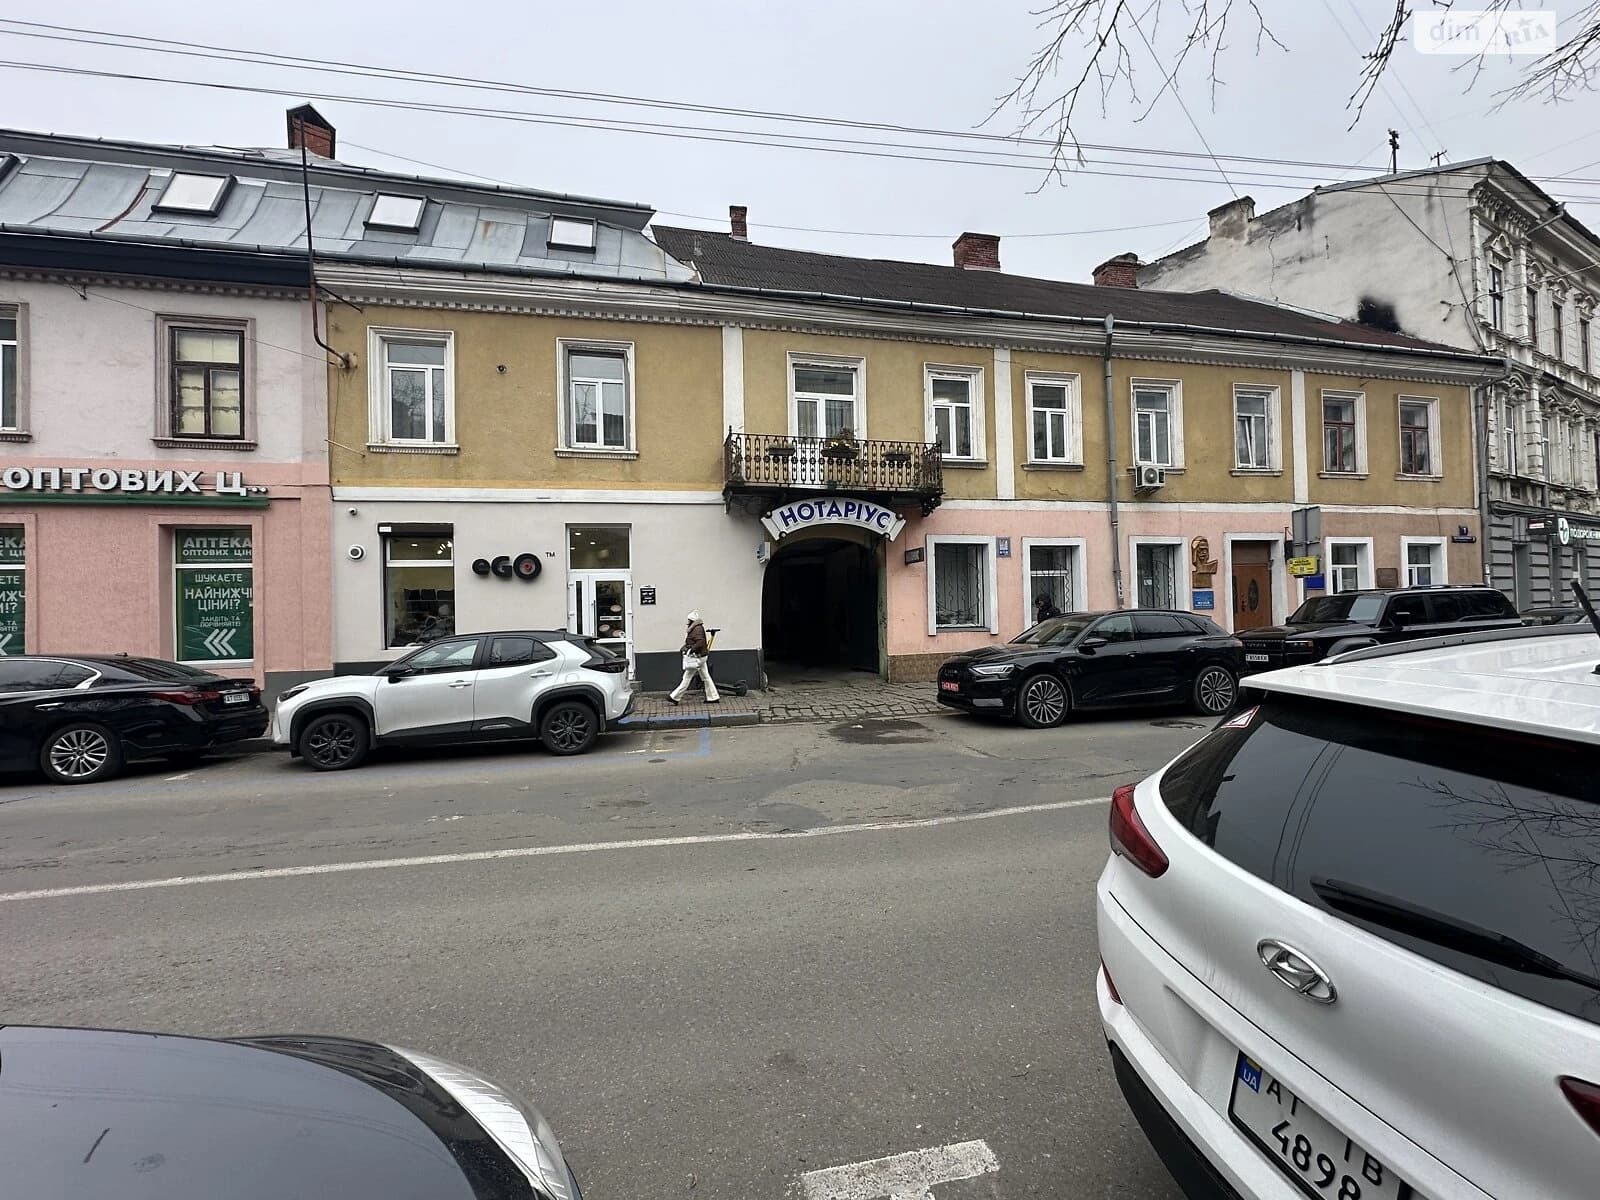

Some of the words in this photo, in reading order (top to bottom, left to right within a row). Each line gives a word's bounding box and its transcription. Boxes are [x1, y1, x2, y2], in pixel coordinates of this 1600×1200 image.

[2, 467, 203, 494] ОПТОВИХ
[779, 500, 891, 529] НОТАРІУС
[183, 537, 252, 548] АПТЕКА
[185, 586, 252, 599] НАЙНИЖЧІ
[198, 599, 241, 611] ЦІНИ!?
[1243, 1069, 1258, 1090] UA
[1266, 1078, 1305, 1116] AT
[1271, 1120, 1361, 1200] 4898
